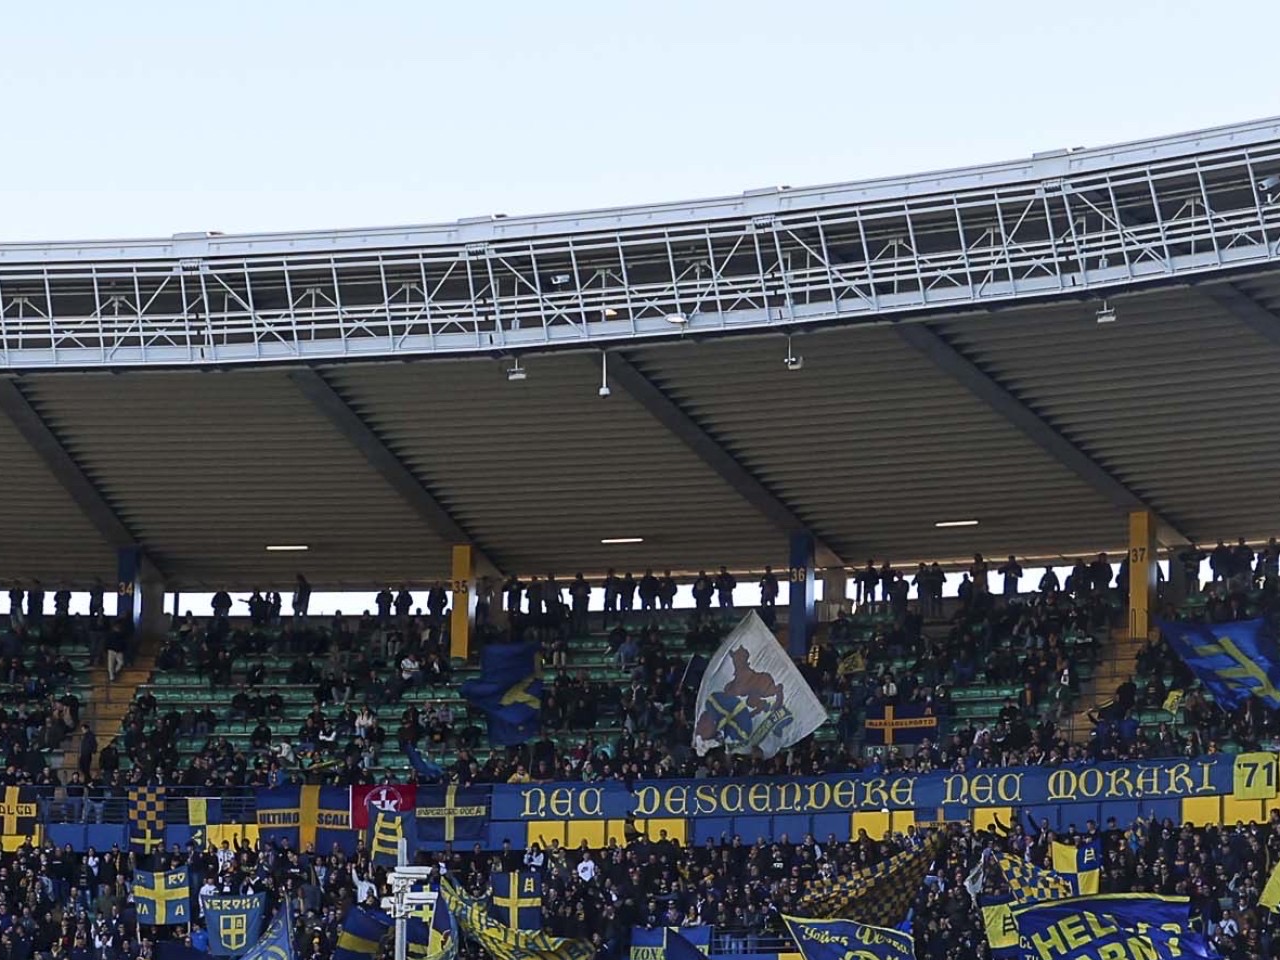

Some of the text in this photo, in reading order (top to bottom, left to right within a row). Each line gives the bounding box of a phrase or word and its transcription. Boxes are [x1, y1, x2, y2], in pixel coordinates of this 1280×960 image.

[1130, 548, 1146, 562] 37
[791, 568, 805, 583] 36
[117, 582, 132, 596] 34
[454, 580, 468, 594] 35
[521, 759, 1218, 817] NEC DESCENDERE NEC MORARI
[258, 812, 300, 828] ULTIMO
